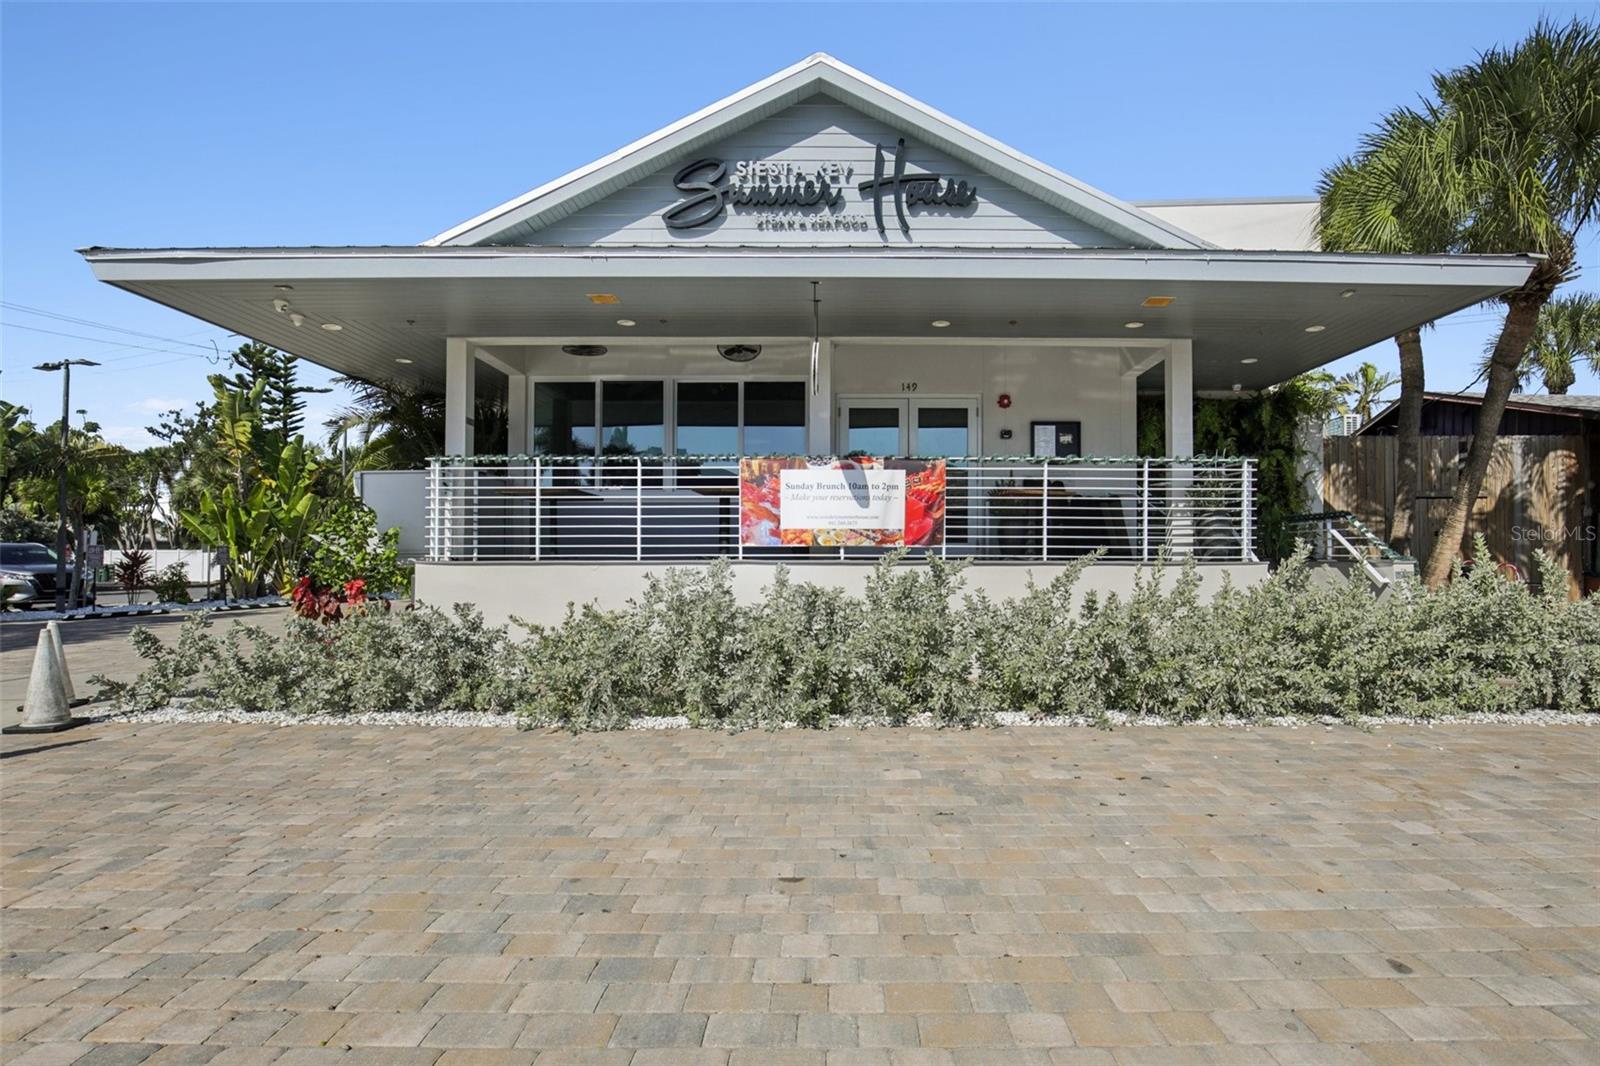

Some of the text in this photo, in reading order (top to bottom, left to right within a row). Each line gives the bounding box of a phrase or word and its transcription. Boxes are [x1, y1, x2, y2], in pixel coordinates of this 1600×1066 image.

[735, 160, 853, 177] SIESTA KEY
[661, 138, 977, 234] Summer House
[757, 213, 795, 223] STEAK
[809, 213, 868, 223] SEAFOOD
[901, 382, 918, 392] 149
[785, 482, 814, 492] Sunday
[816, 482, 845, 490] Brunch
[848, 482, 869, 490] 10am
[881, 483, 899, 492] 2pm
[790, 493, 810, 501] Make
[871, 493, 893, 503] today
